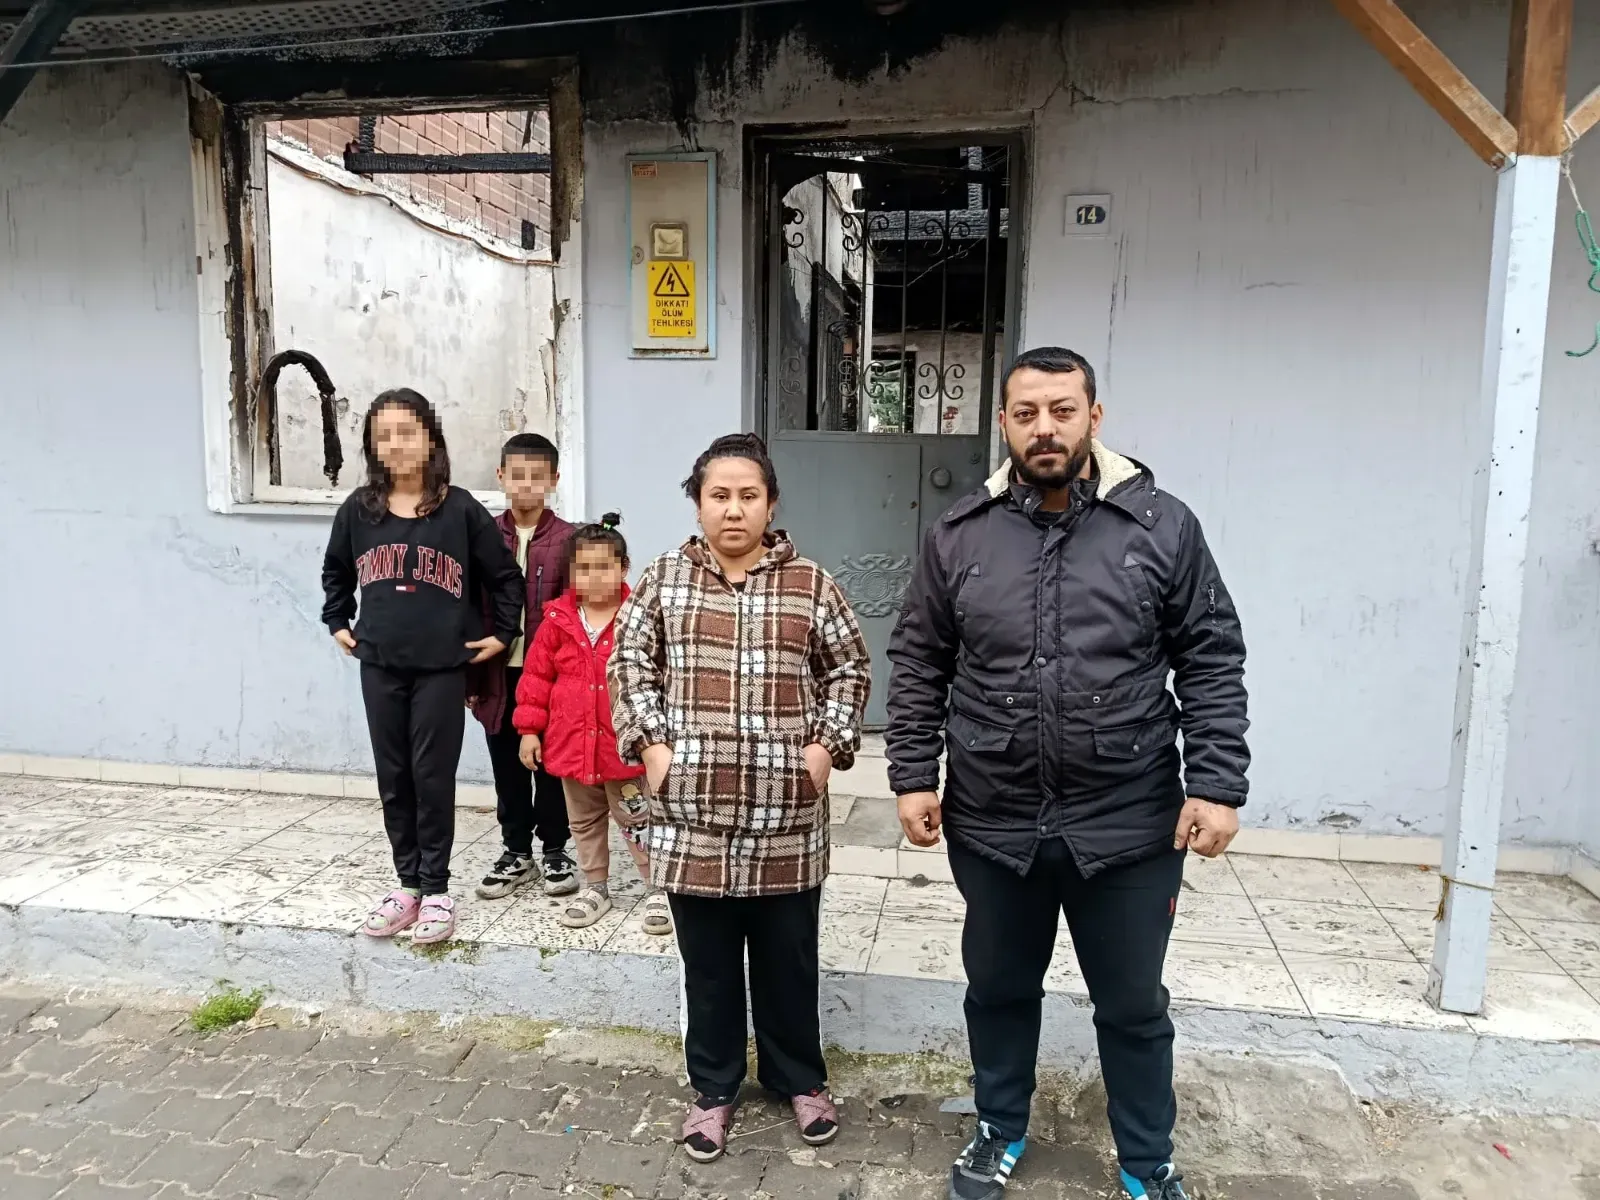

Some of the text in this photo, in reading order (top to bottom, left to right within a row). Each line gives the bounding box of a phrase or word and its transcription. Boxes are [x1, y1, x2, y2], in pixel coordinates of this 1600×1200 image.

[1078, 207, 1097, 224] 14
[662, 308, 683, 316] ÖLÜM
[652, 318, 693, 326] TEHLİKESİ
[413, 546, 463, 598] JEANS
